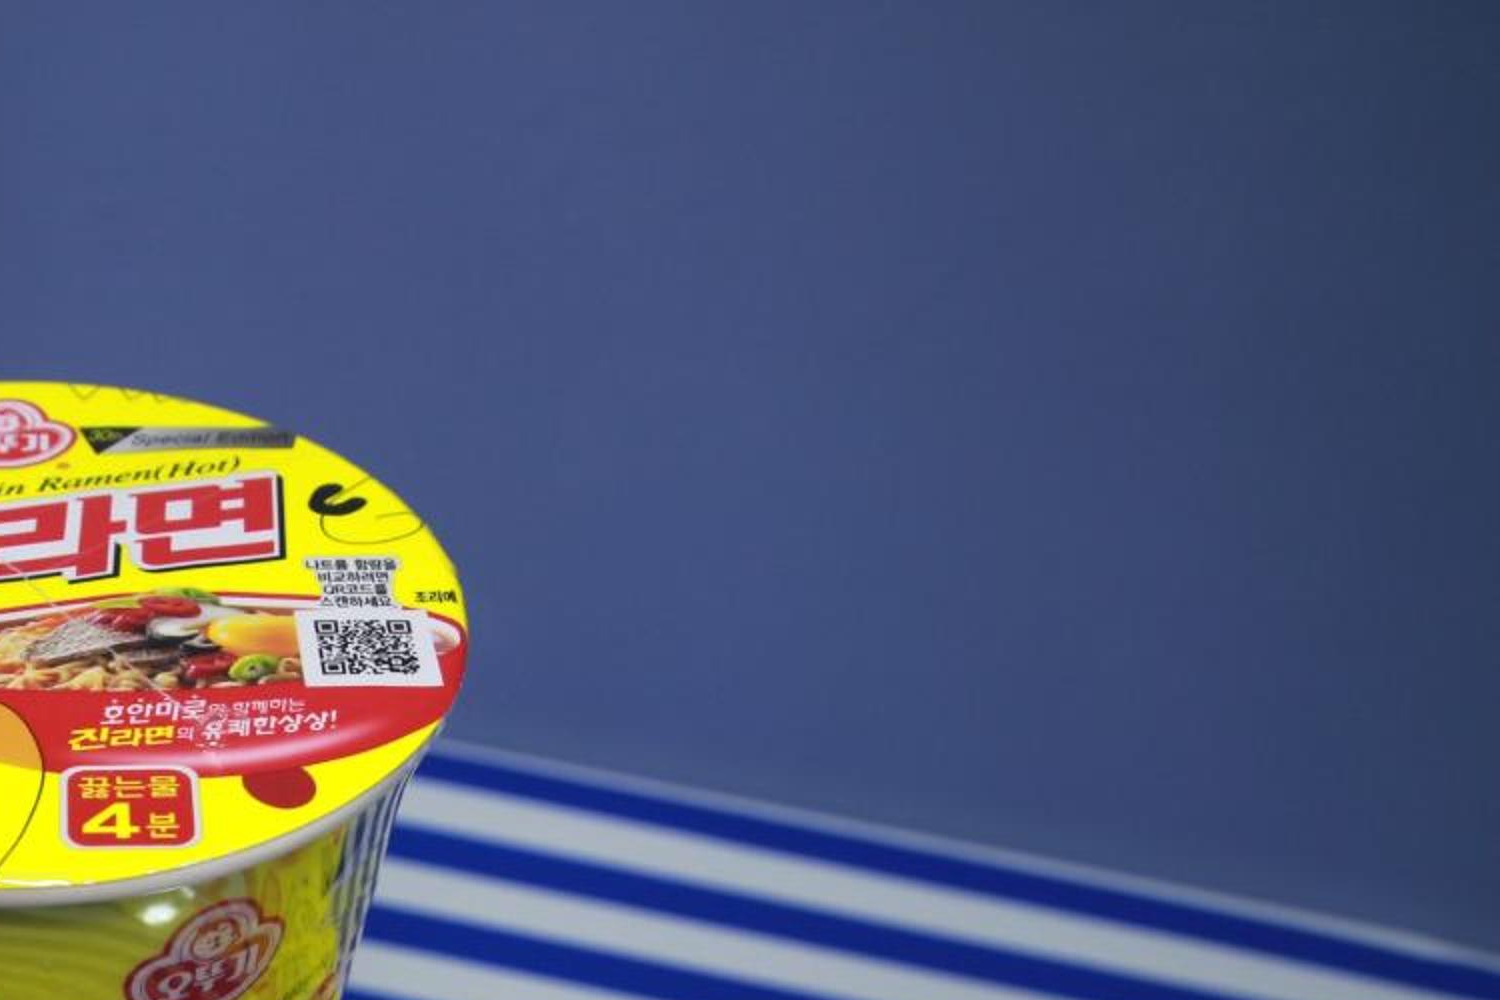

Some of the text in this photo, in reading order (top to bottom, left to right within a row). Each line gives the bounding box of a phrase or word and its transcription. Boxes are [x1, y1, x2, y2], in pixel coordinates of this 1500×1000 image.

[131, 431, 211, 448] Special
[317, 572, 389, 583] 비교하려면
[323, 584, 388, 595] QR코드를
[321, 596, 392, 607] 스캔하세요
[78, 775, 181, 800] 끓는물
